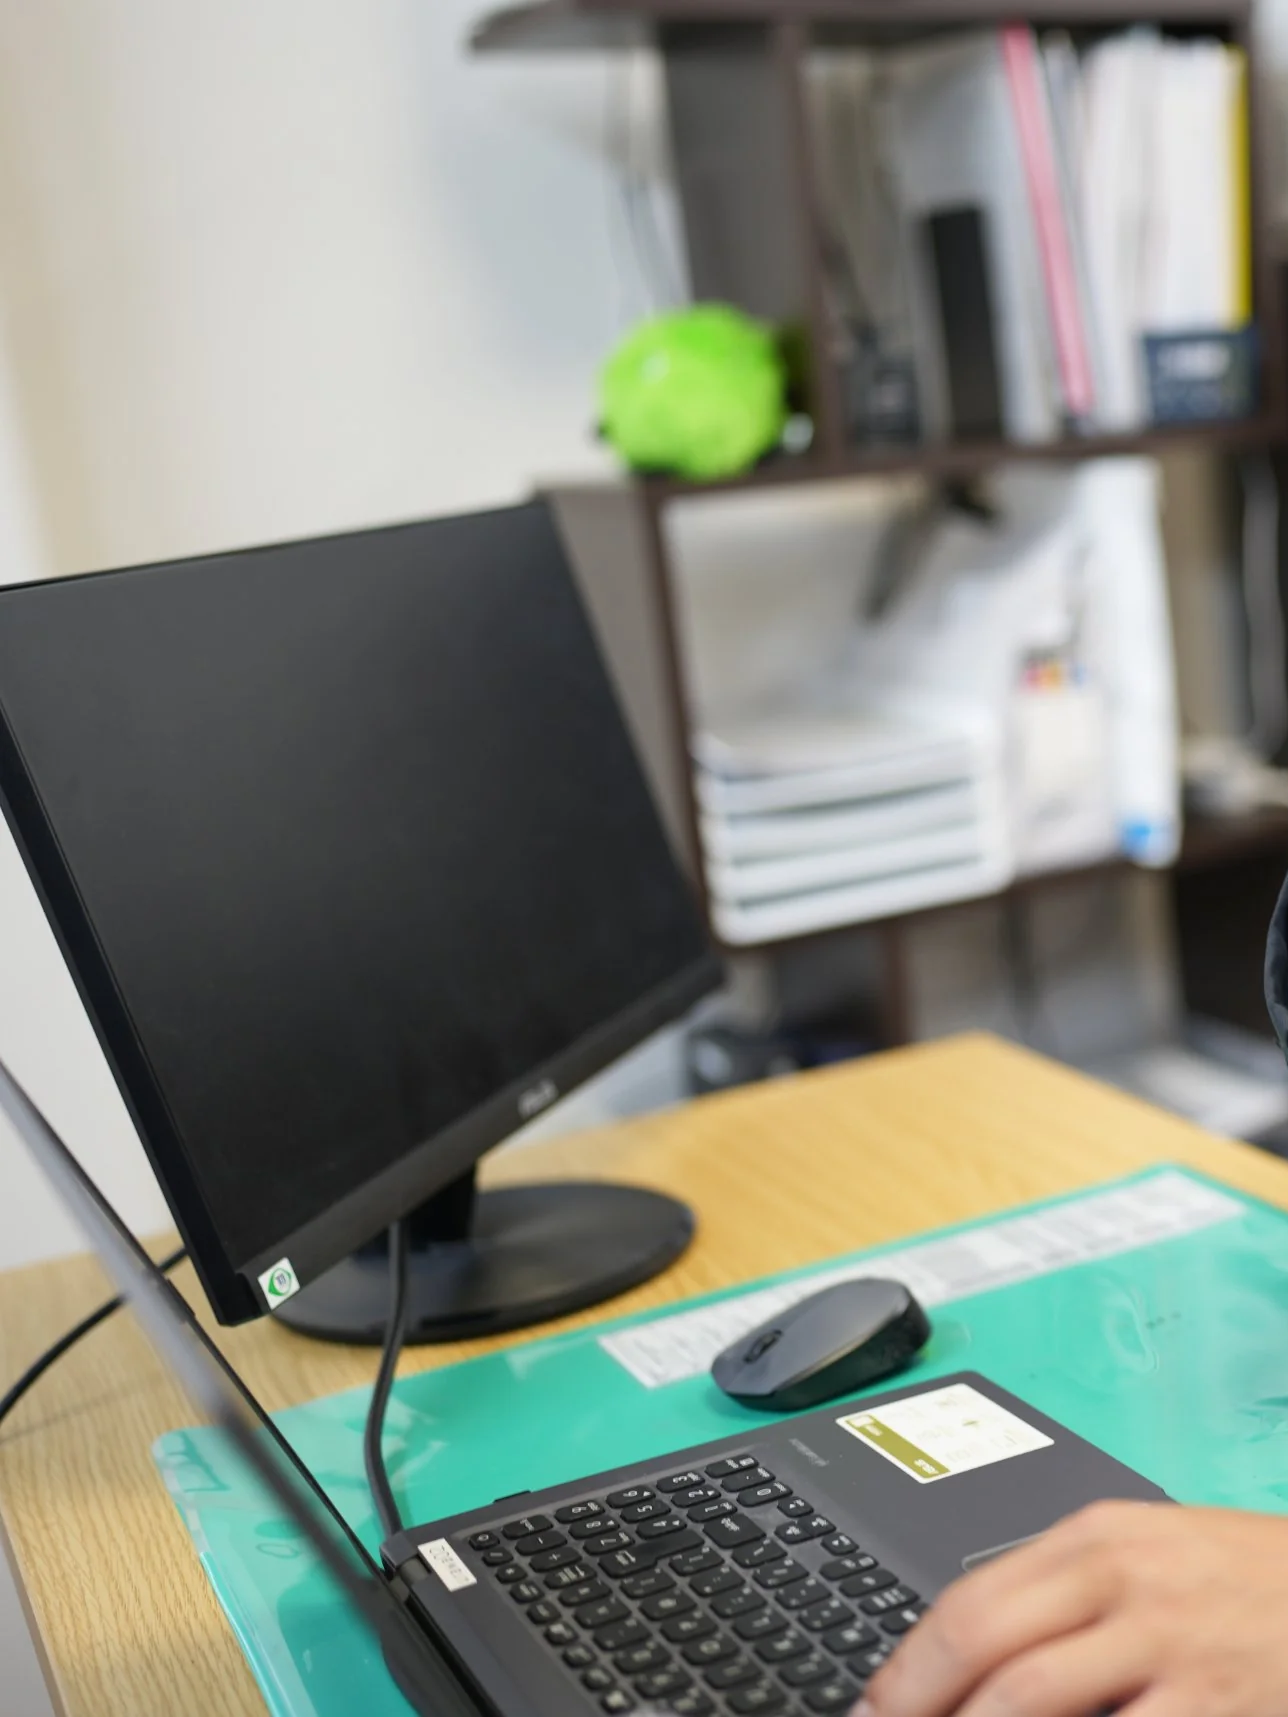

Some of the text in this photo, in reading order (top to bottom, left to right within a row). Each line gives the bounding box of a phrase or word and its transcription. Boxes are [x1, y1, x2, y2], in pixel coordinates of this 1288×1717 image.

[672, 1475, 688, 1484] 3
[623, 1489, 638, 1498] 6
[688, 1489, 704, 1498] 2
[756, 1488, 772, 1496] 0
[571, 1506, 587, 1514] 9
[637, 1504, 653, 1513] 5
[586, 1520, 601, 1529] 8
[652, 1520, 667, 1528] 4
[600, 1538, 617, 1546] 7
